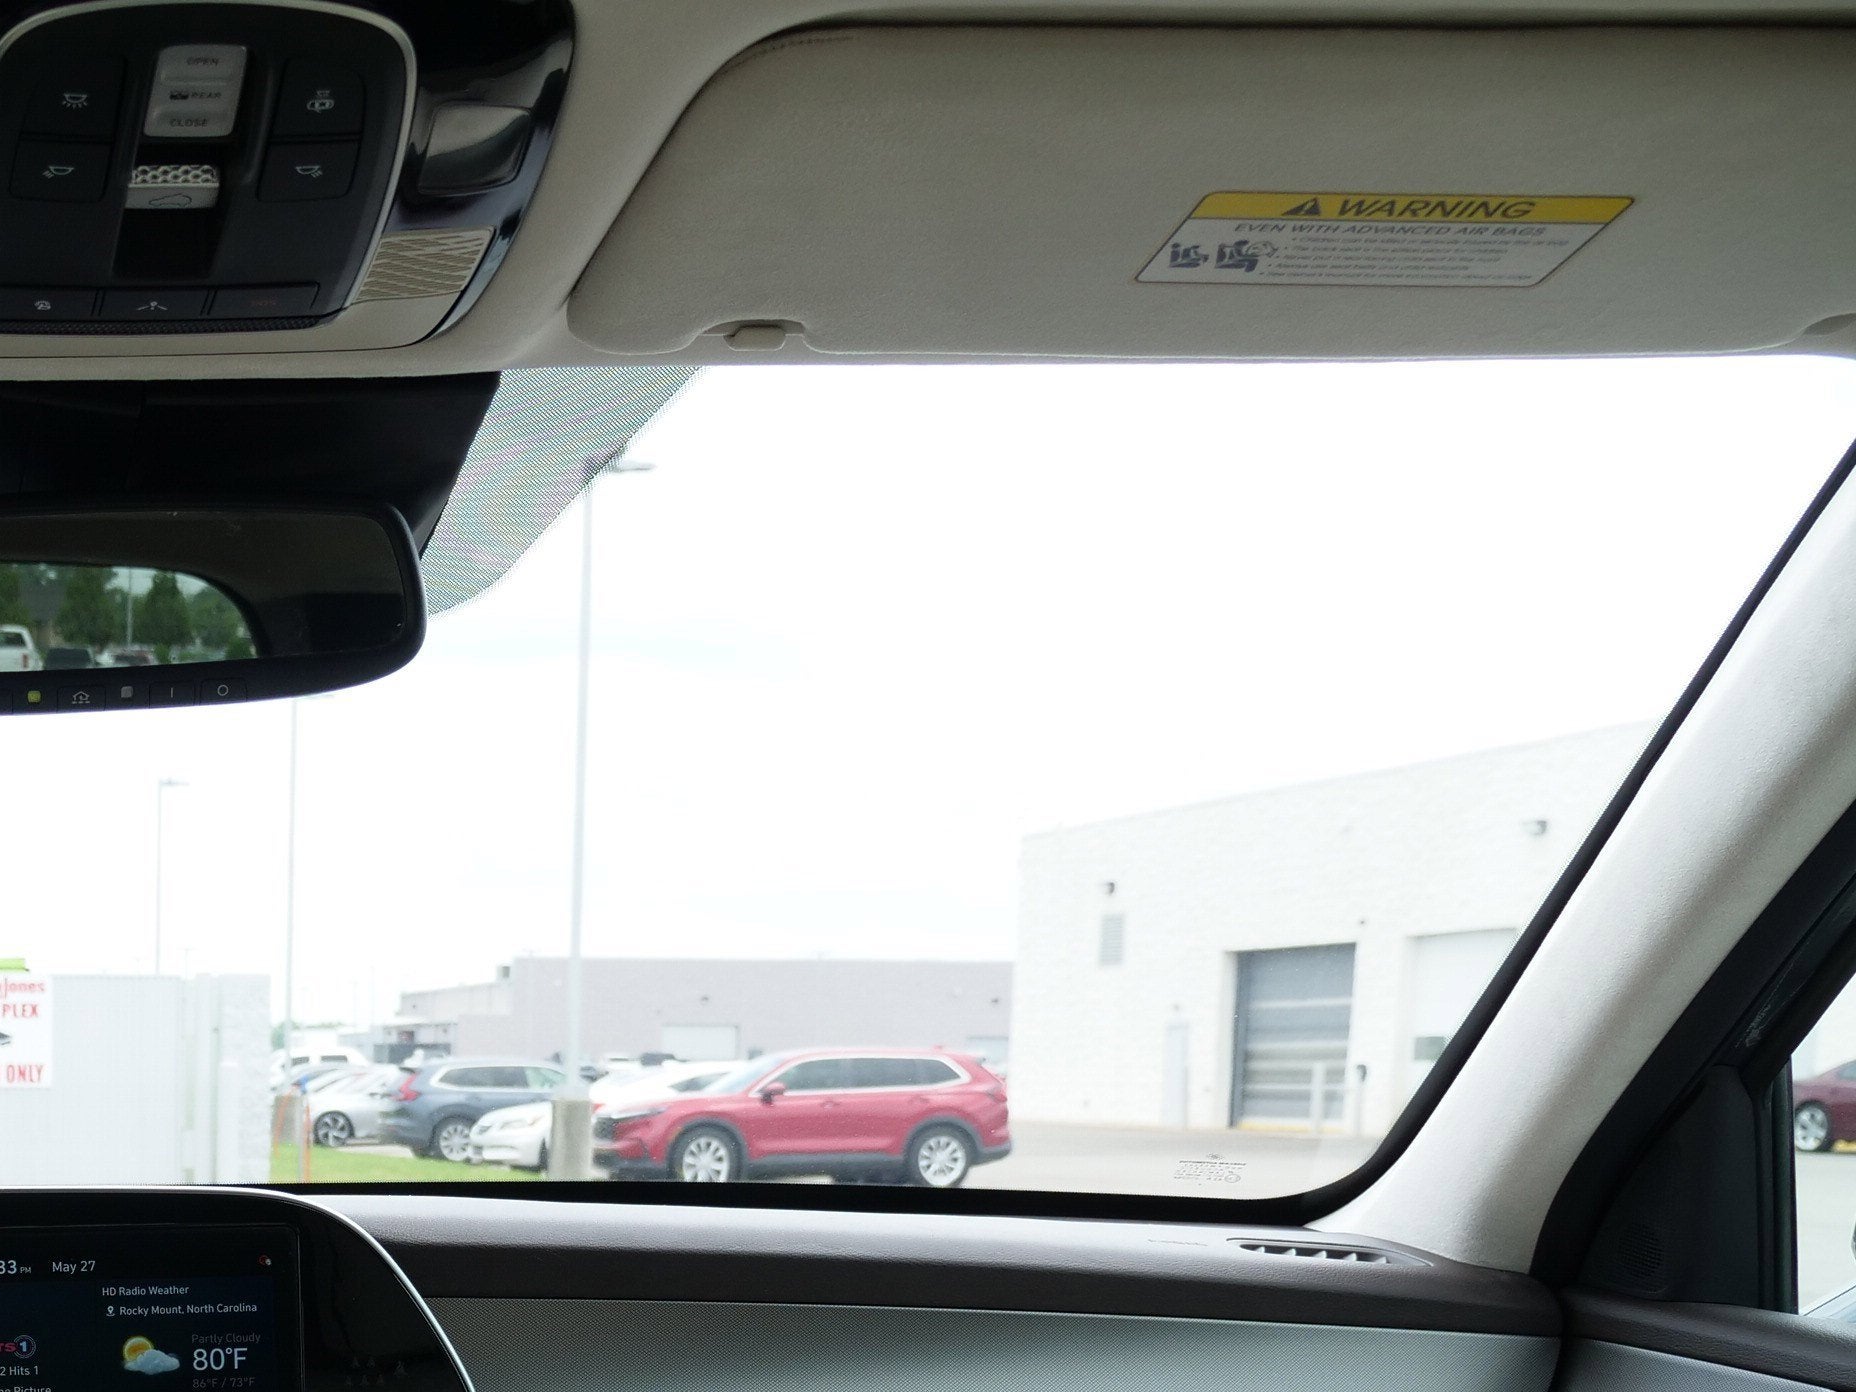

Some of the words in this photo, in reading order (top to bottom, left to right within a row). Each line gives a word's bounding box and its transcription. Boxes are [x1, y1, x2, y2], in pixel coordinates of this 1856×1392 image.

[1338, 199, 1535, 219] WARNING
[1234, 223, 1286, 233] EVEN
[1291, 224, 1340, 234] WITH
[1343, 225, 1451, 235] ADVANCED
[1454, 227, 1490, 236] AIR
[1493, 227, 1546, 237] BAGS
[2, 1004, 38, 1018] PLEX
[6, 1064, 44, 1084] ONLY
[20, 1266, 32, 1274] PM
[52, 1261, 77, 1275] May
[80, 1260, 96, 1272] 27
[101, 1286, 117, 1296] HD
[118, 1286, 147, 1296] Radio
[148, 1285, 189, 1296] Weather
[119, 1305, 149, 1317] Rocky
[186, 1303, 215, 1314] North
[216, 1302, 258, 1314] Carolina
[191, 1333, 223, 1344] Partly
[225, 1332, 261, 1344] Cloudy
[19, 1340, 28, 1352] 1
[192, 1347, 248, 1371] 80°F
[0, 1366, 6, 1377] 2
[9, 1366, 30, 1377] Hits
[33, 1365, 39, 1376] 1
